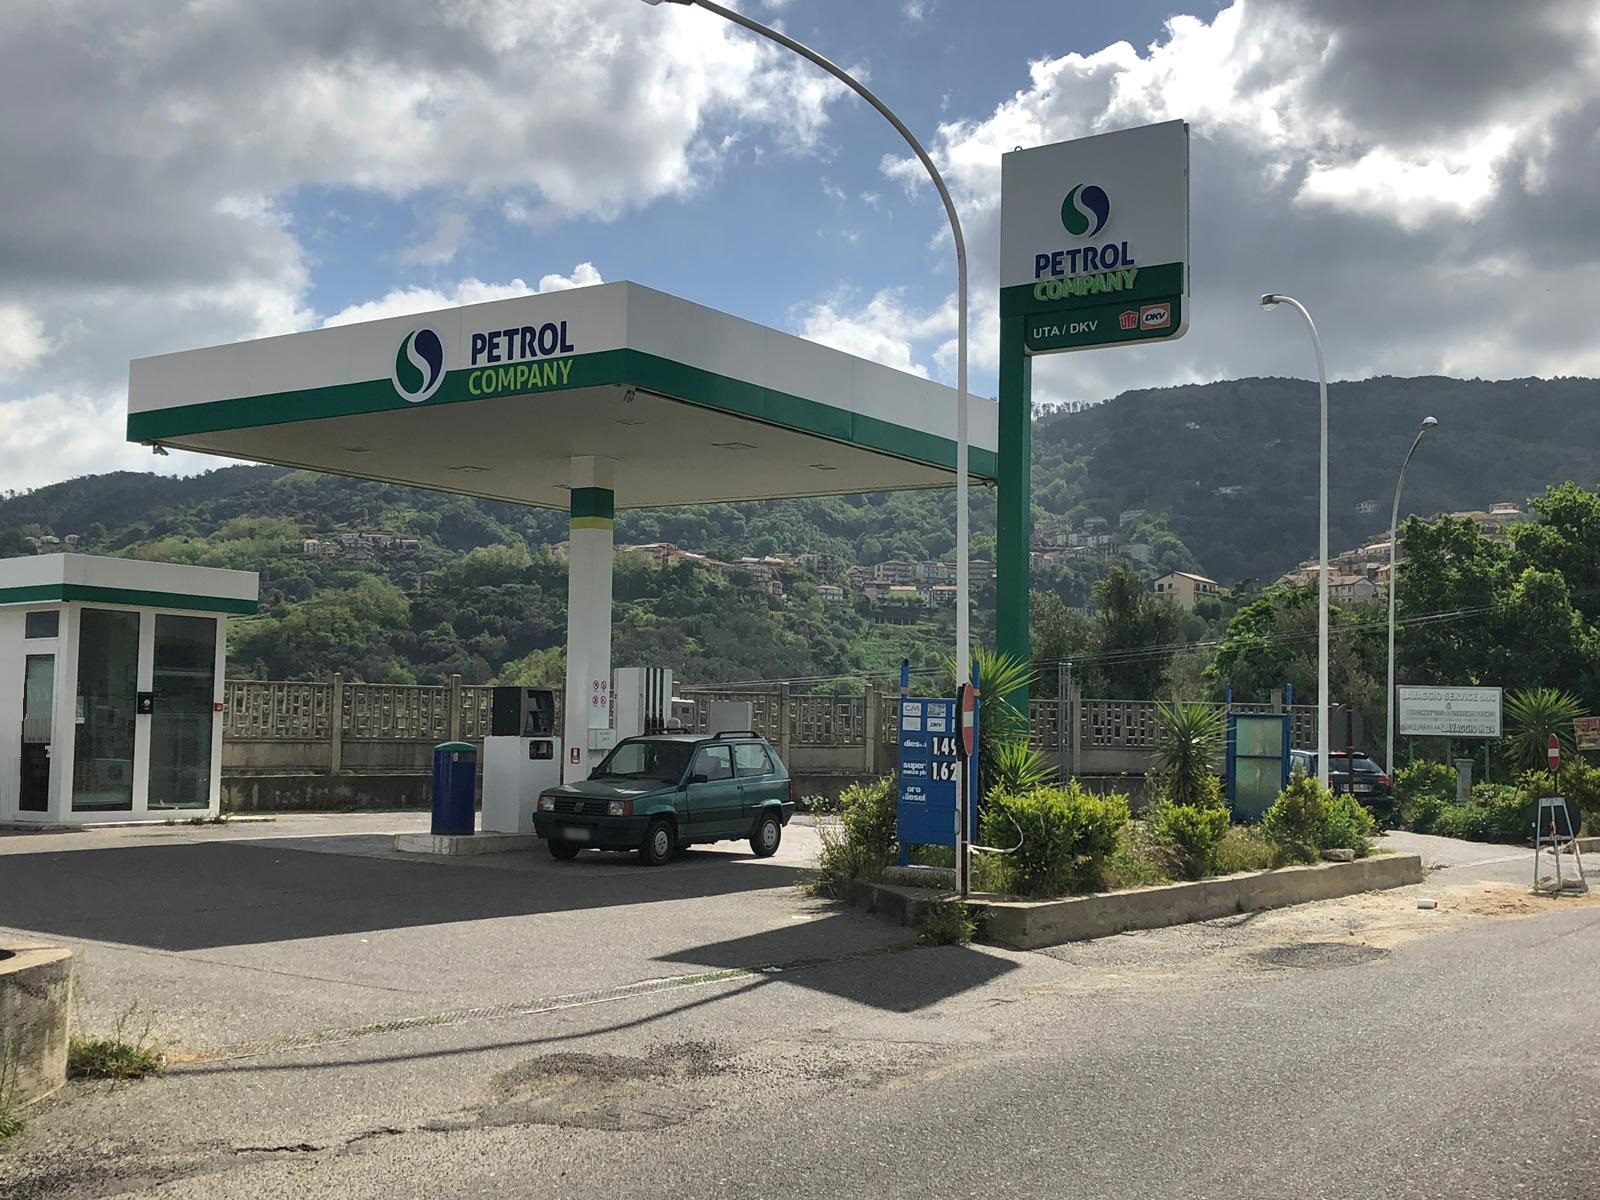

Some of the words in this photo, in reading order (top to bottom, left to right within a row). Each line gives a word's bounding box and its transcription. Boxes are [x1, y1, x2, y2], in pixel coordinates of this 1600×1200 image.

[1034, 241, 1135, 279] PETROL
[1033, 268, 1138, 301] COMPANY
[1120, 313, 1137, 329] UTA
[1144, 311, 1167, 322] DKV
[1033, 326, 1060, 339] UTA
[1062, 323, 1067, 336] /
[1070, 320, 1099, 334] DKV
[471, 320, 574, 366] PETROL
[468, 359, 574, 395] COMPANY
[1443, 691, 1478, 702] SERVICE
[903, 762, 927, 771] super
